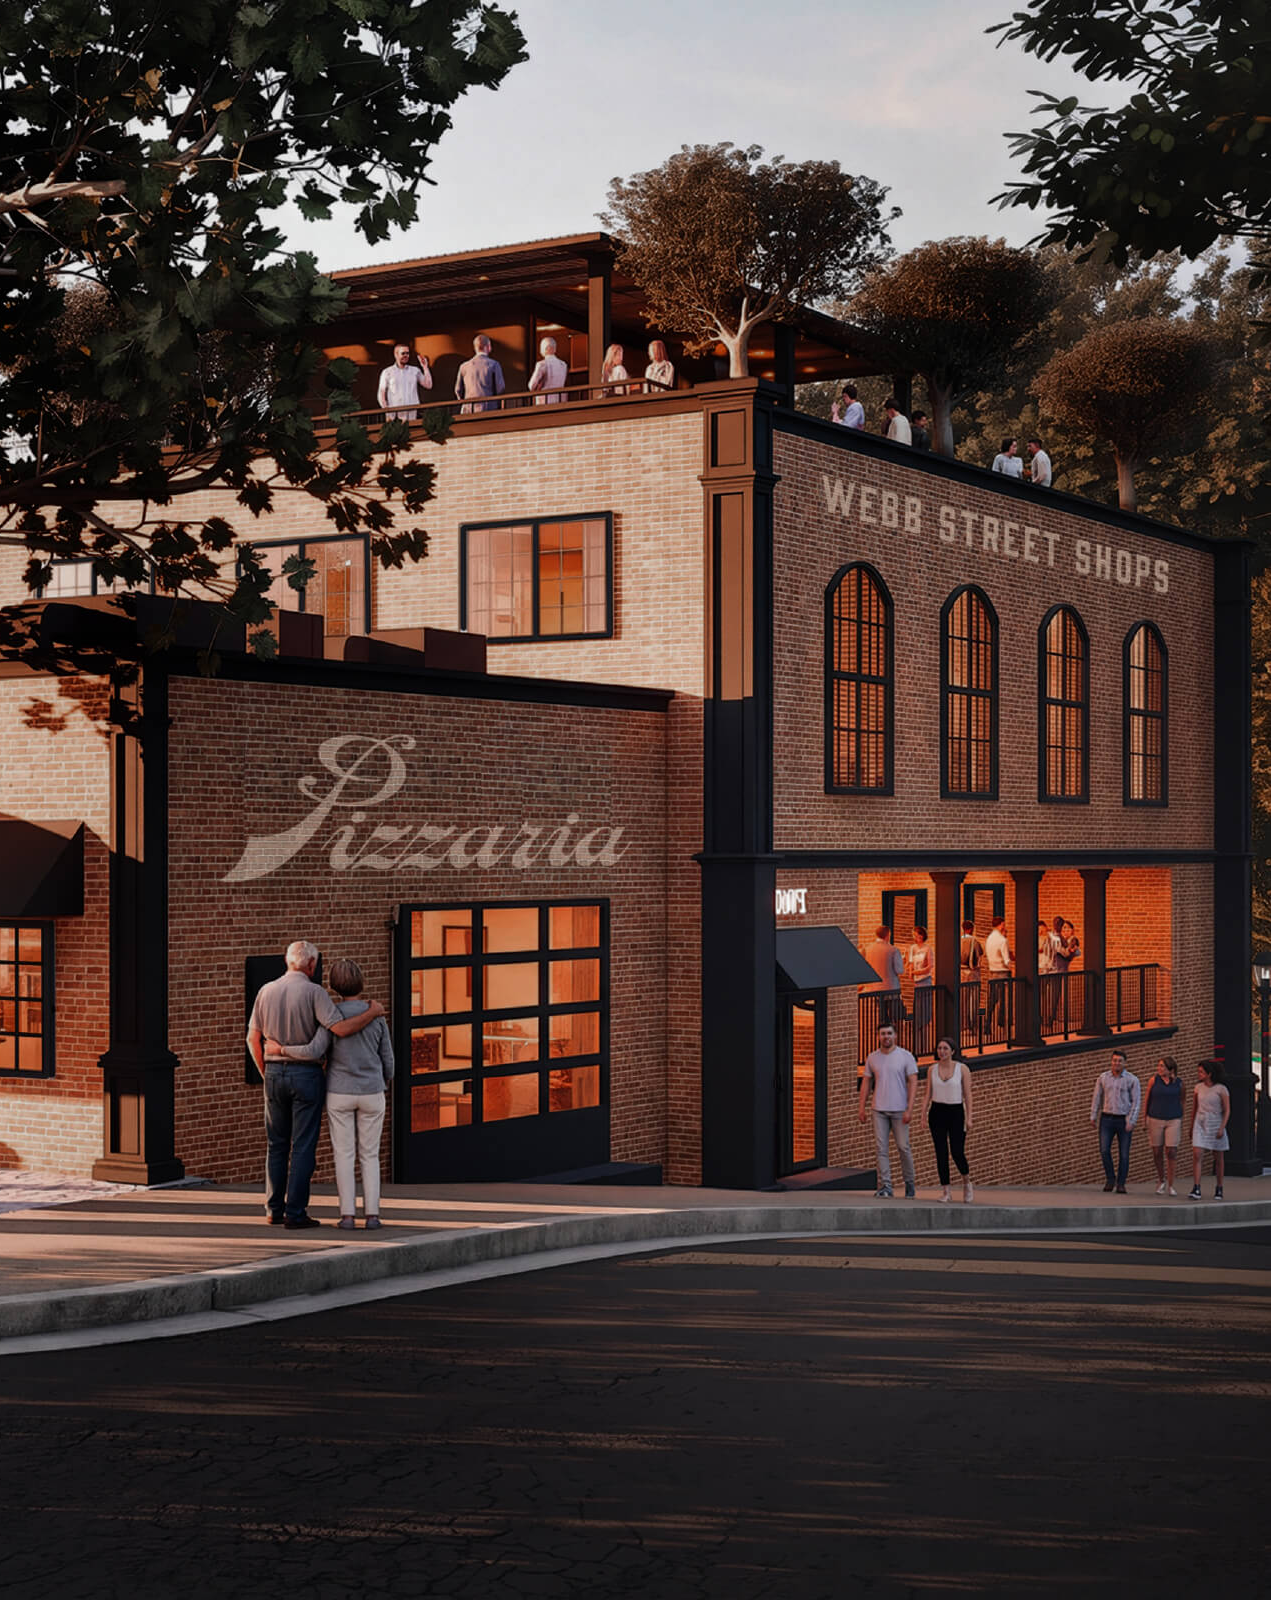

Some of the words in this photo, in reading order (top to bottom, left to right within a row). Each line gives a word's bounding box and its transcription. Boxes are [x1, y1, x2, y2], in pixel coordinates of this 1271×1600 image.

[822, 475, 922, 534] WEBB
[939, 505, 1061, 567] STREET
[1076, 540, 1170, 593] SHOPS
[220, 734, 632, 882] Pizzaria
